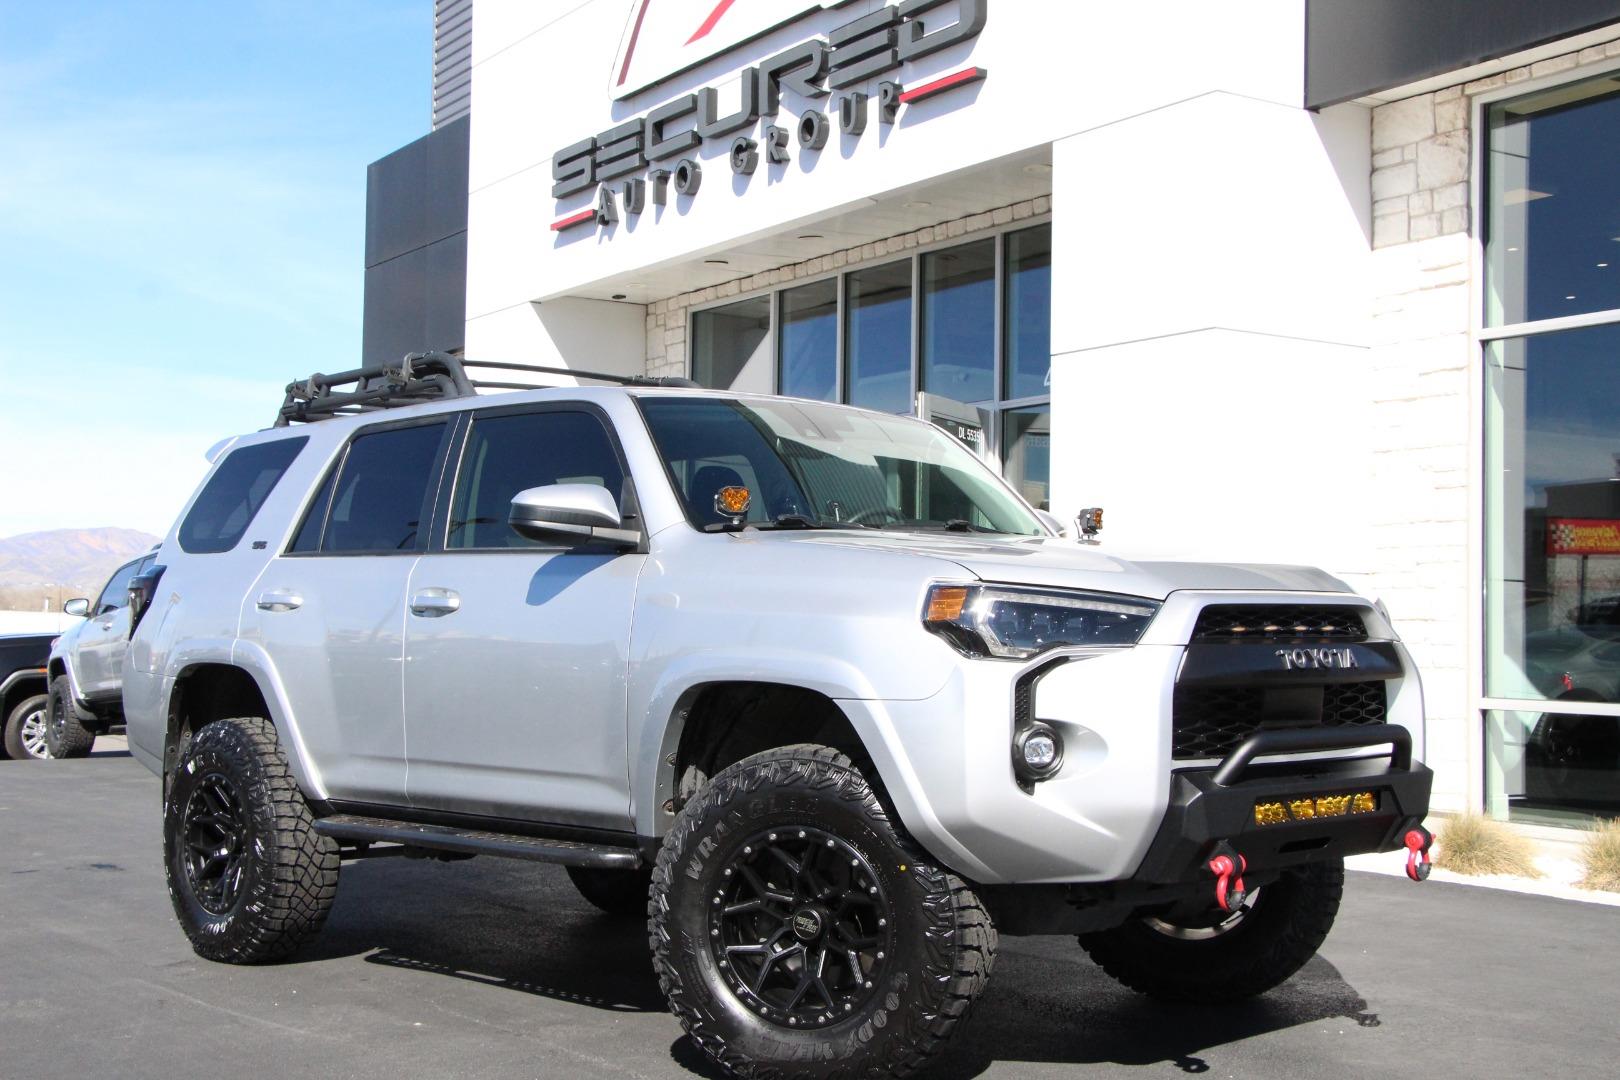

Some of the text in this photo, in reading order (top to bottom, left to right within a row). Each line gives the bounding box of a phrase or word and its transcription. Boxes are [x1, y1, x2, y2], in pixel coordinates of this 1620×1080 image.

[552, 0, 987, 199] SECURED
[596, 81, 902, 229] AUTO GROUP
[958, 426, 966, 440] DL
[1275, 647, 1359, 670] TOYOTA
